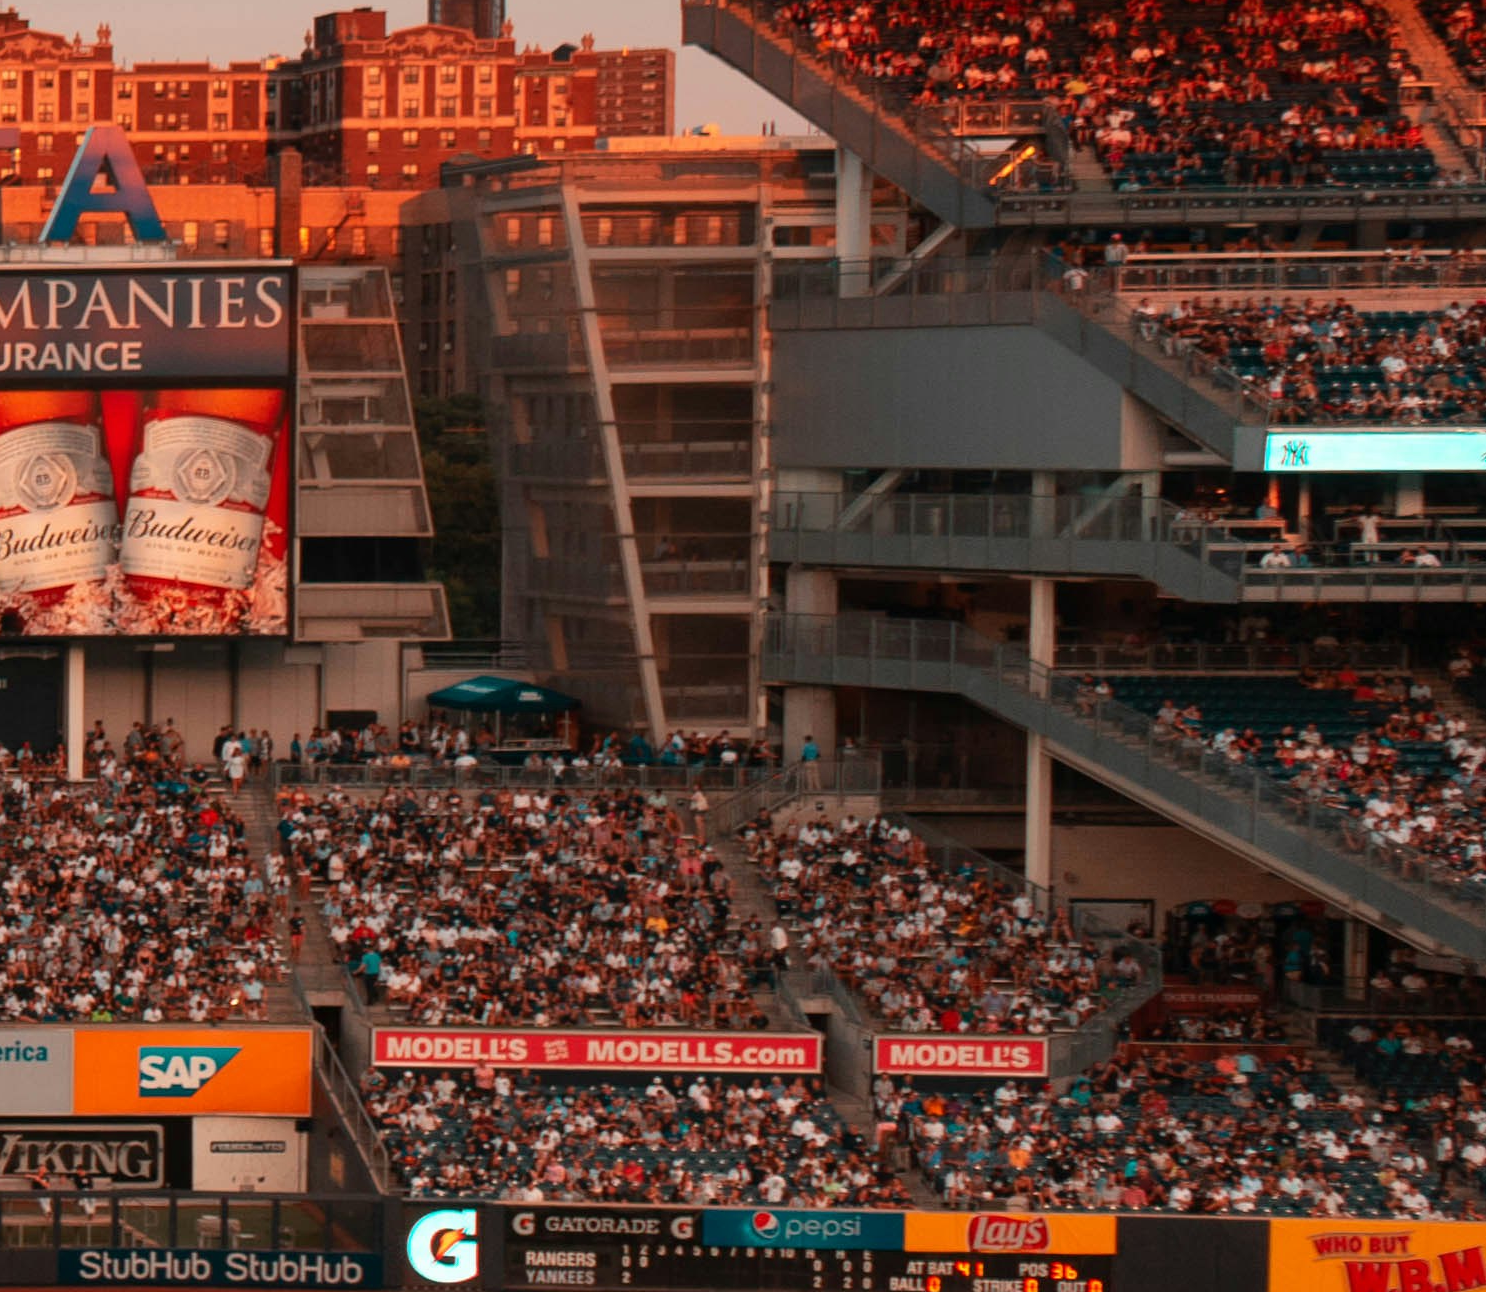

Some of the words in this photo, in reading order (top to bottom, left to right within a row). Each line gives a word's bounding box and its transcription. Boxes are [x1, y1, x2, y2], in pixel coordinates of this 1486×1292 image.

[127, 509, 258, 553] Budweiser
[385, 1036, 528, 1062] MODELL'S
[587, 1040, 806, 1066] MODELLS.com
[889, 1042, 1032, 1071] MODELL'S
[139, 1055, 217, 1090] SAP
[545, 1216, 660, 1235] GATORADE
[785, 1216, 862, 1240] pepsi
[1313, 1236, 1362, 1255] WHO
[1369, 1234, 1412, 1254] BUT
[79, 1251, 212, 1281] StubHub
[225, 1253, 363, 1284] StubHub
[525, 1250, 596, 1268] RANGERS
[526, 1270, 595, 1285] YANKEES
[889, 1277, 925, 1292] BALL
